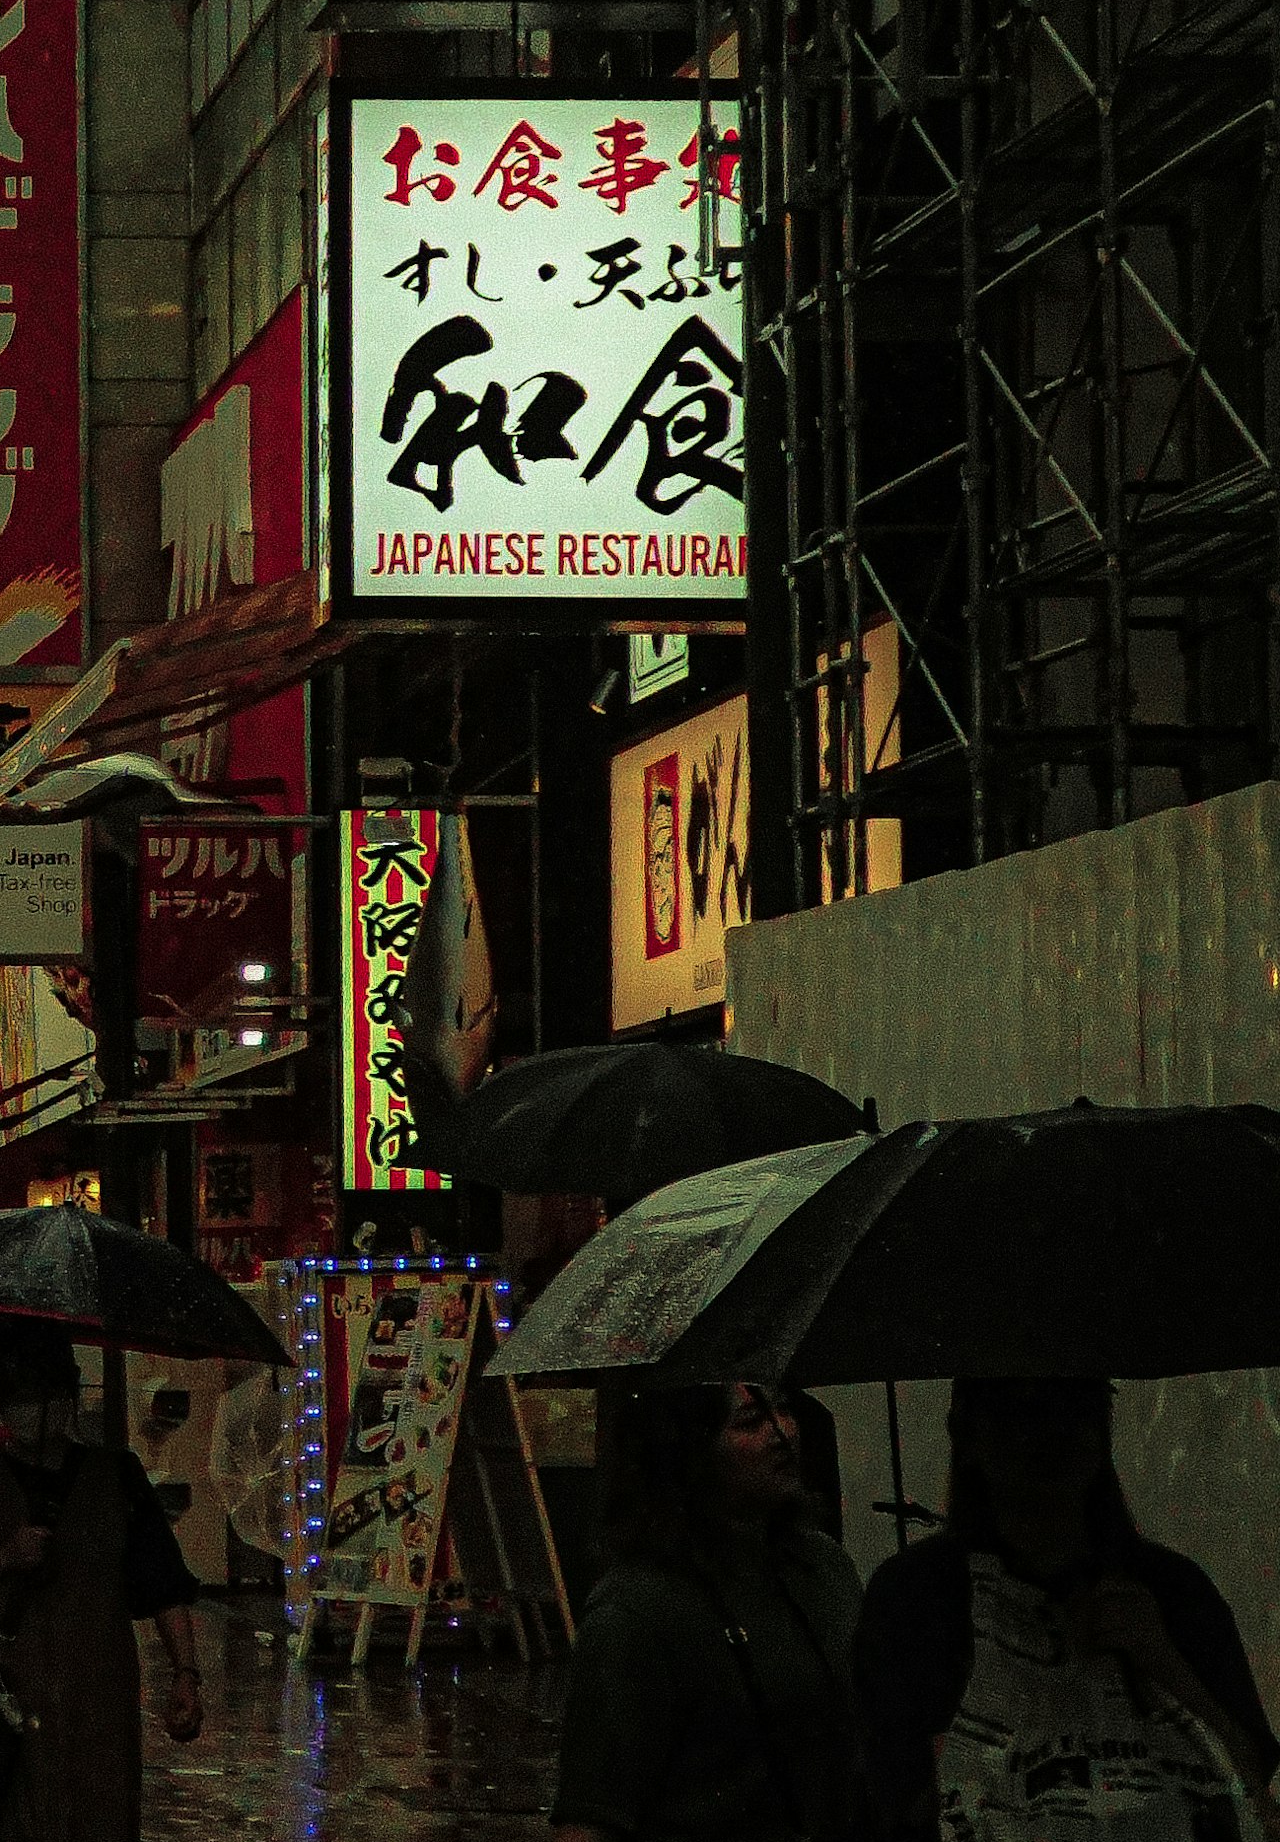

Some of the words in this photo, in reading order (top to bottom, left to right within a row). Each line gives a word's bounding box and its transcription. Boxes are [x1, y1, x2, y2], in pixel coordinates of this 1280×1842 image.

[379, 315, 745, 516] 和食
[371, 532, 546, 577] JAPANESE
[5, 847, 75, 867] Japan.
[147, 836, 285, 879] ツルハ
[26, 894, 76, 918] Shop
[149, 889, 261, 919] ドラッグ
